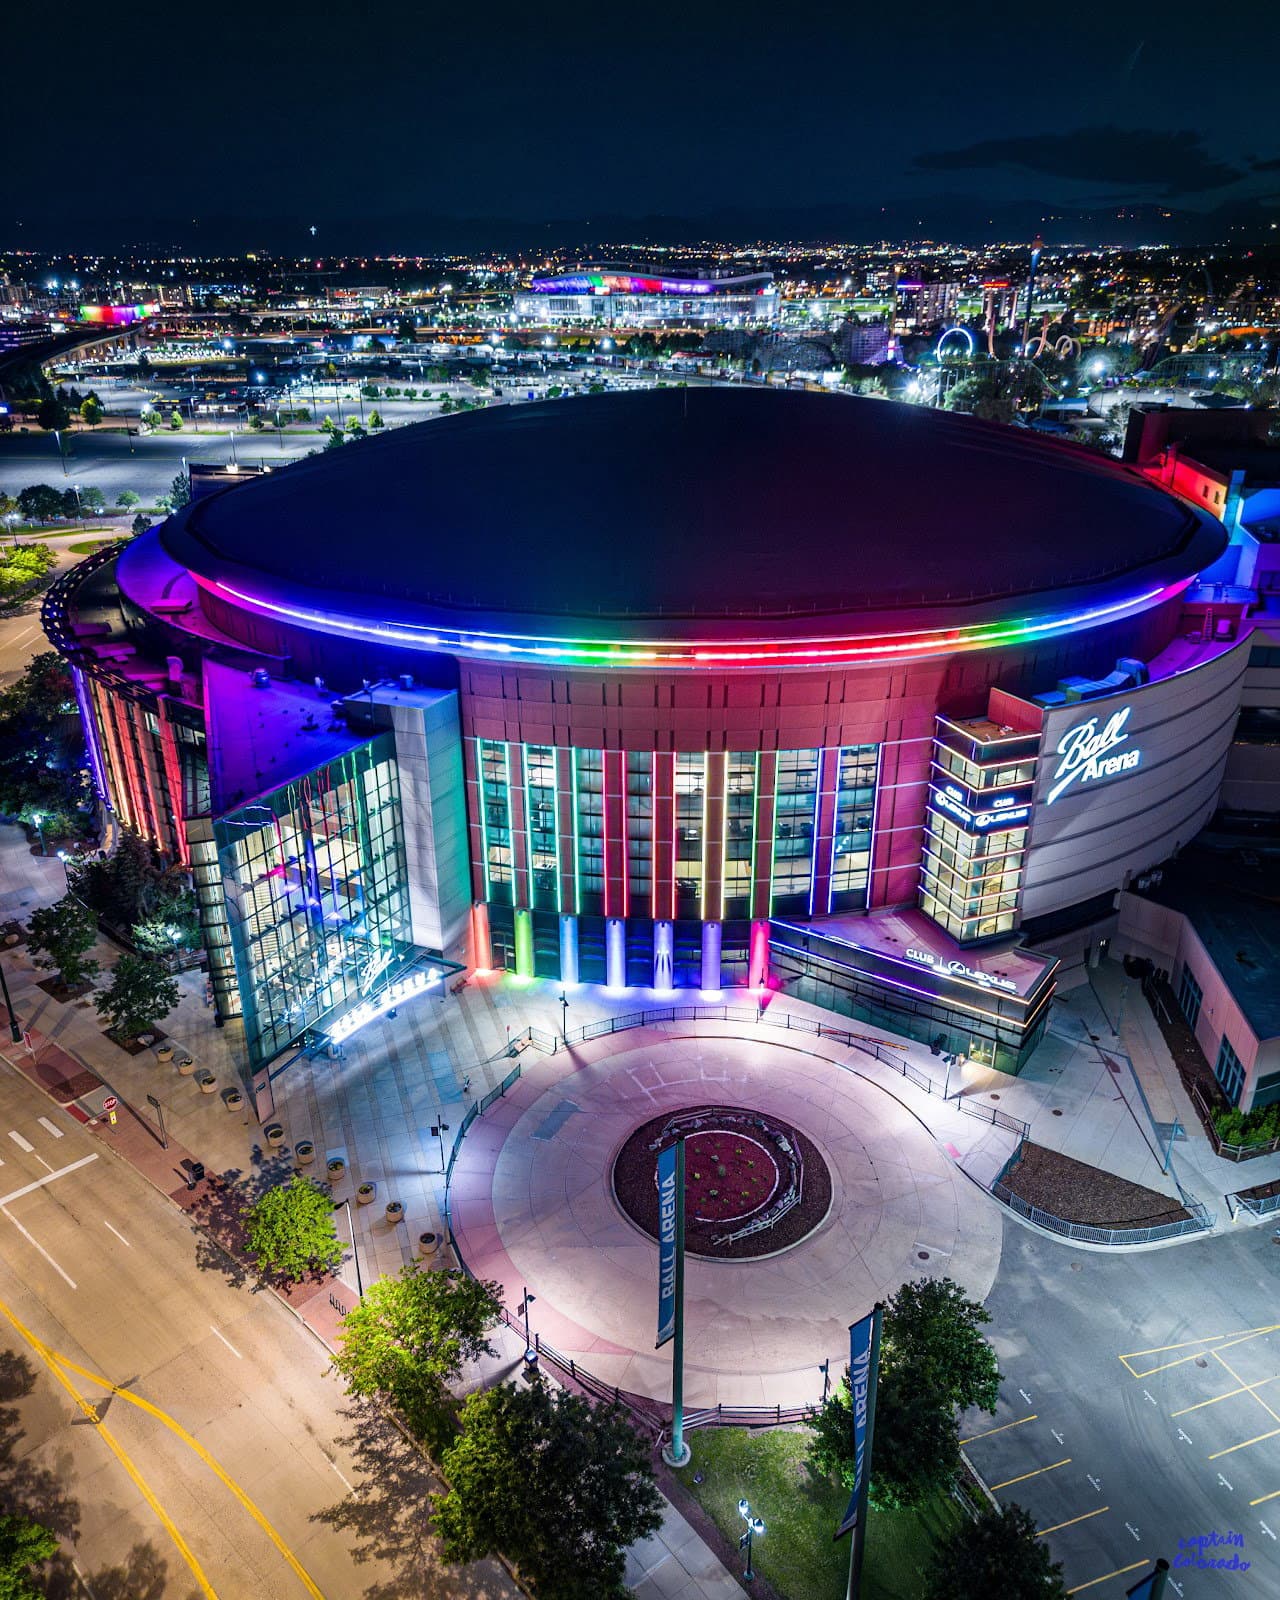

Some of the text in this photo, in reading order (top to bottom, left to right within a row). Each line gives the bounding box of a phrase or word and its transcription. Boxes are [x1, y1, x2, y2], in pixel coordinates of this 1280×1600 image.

[1047, 706, 1130, 805] Ball
[1081, 750, 1140, 782] Arena
[906, 948, 1017, 990] CLUB LEXUS
[662, 1171, 675, 1300] BALL ARENA
[853, 1349, 871, 1430] ARENA
